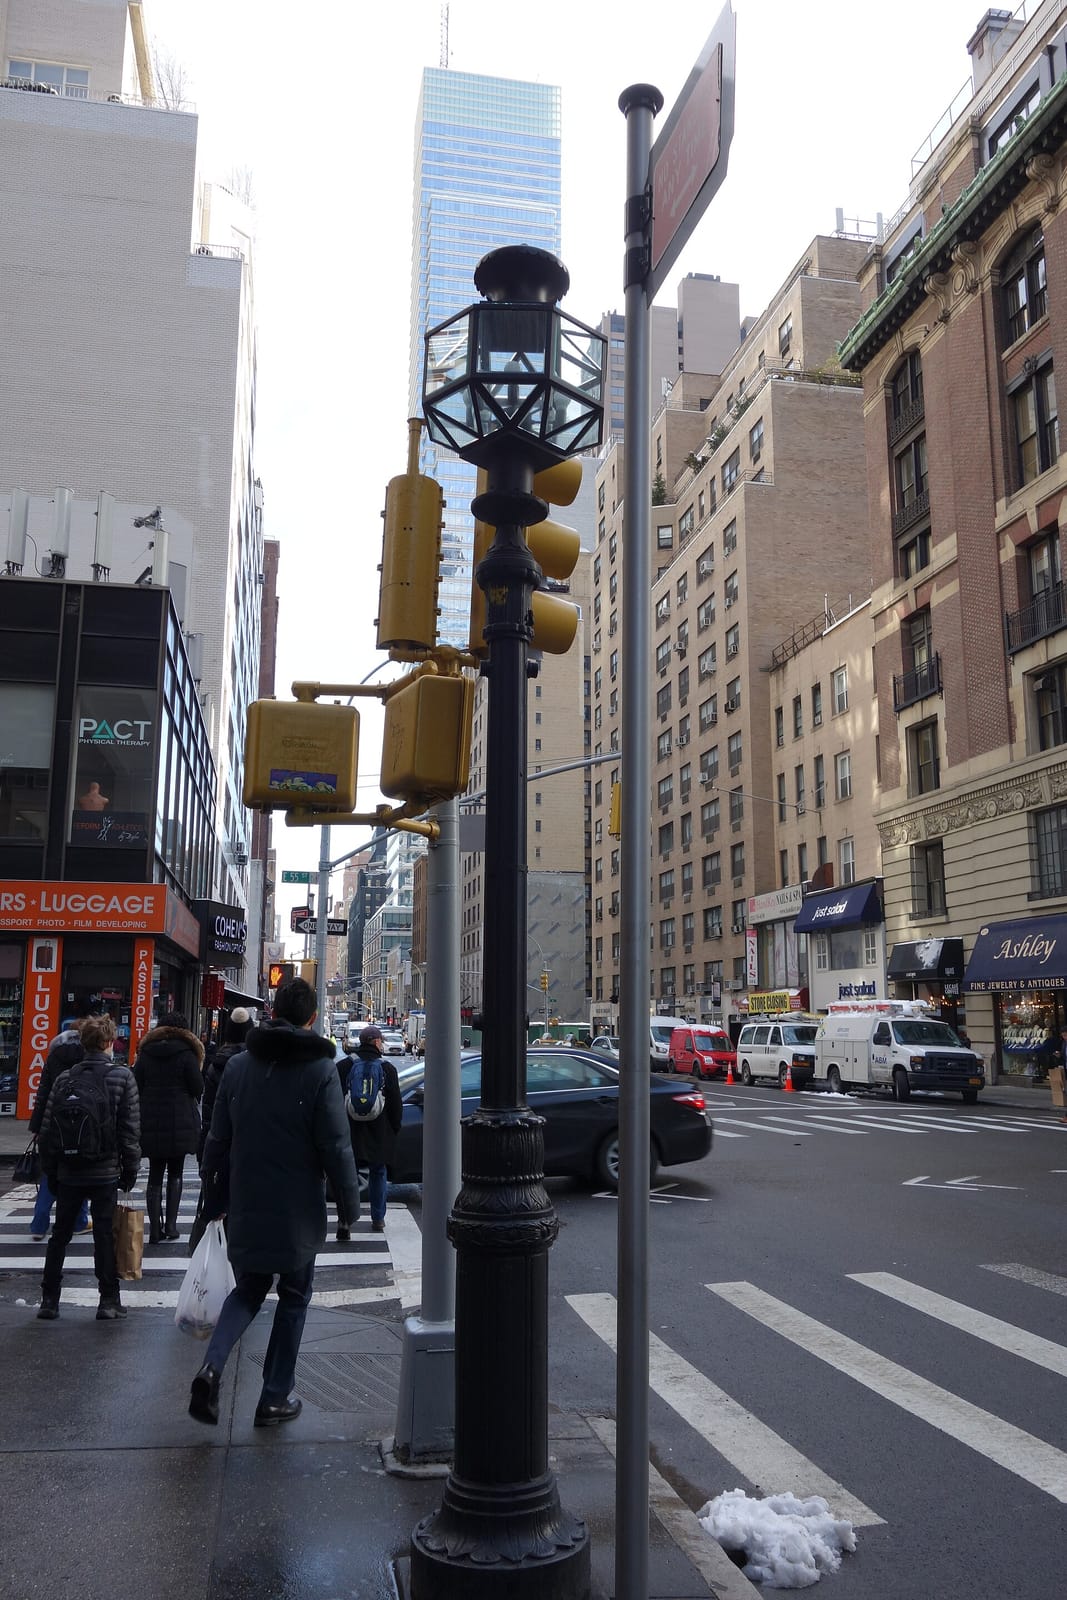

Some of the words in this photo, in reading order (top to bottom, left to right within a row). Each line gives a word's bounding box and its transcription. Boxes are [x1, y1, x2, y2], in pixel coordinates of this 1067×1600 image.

[79, 718, 152, 740] PACT
[116, 739, 151, 747] THERAPY
[283, 871, 288, 882] E
[290, 872, 299, 881] 55
[40, 890, 155, 914] LUGGAGE
[812, 905, 827, 921] just
[826, 900, 848, 915] salad
[37, 919, 65, 927] PHOTO
[96, 920, 147, 928] DEVELOPING
[215, 915, 248, 941] COHEN'S
[303, 921, 317, 929] ONE
[748, 939, 757, 978] NAILS
[993, 933, 1057, 964] Ashley
[135, 949, 148, 1039] PASSPORT
[838, 983, 854, 1000] just
[854, 981, 876, 997] salad
[970, 982, 985, 990] FINE
[987, 980, 1018, 990] JEWELRY
[1020, 980, 1025, 988] &
[1027, 978, 1065, 988] ANTIQUES
[750, 995, 767, 1010] STORE
[767, 994, 788, 1009] CLOSING
